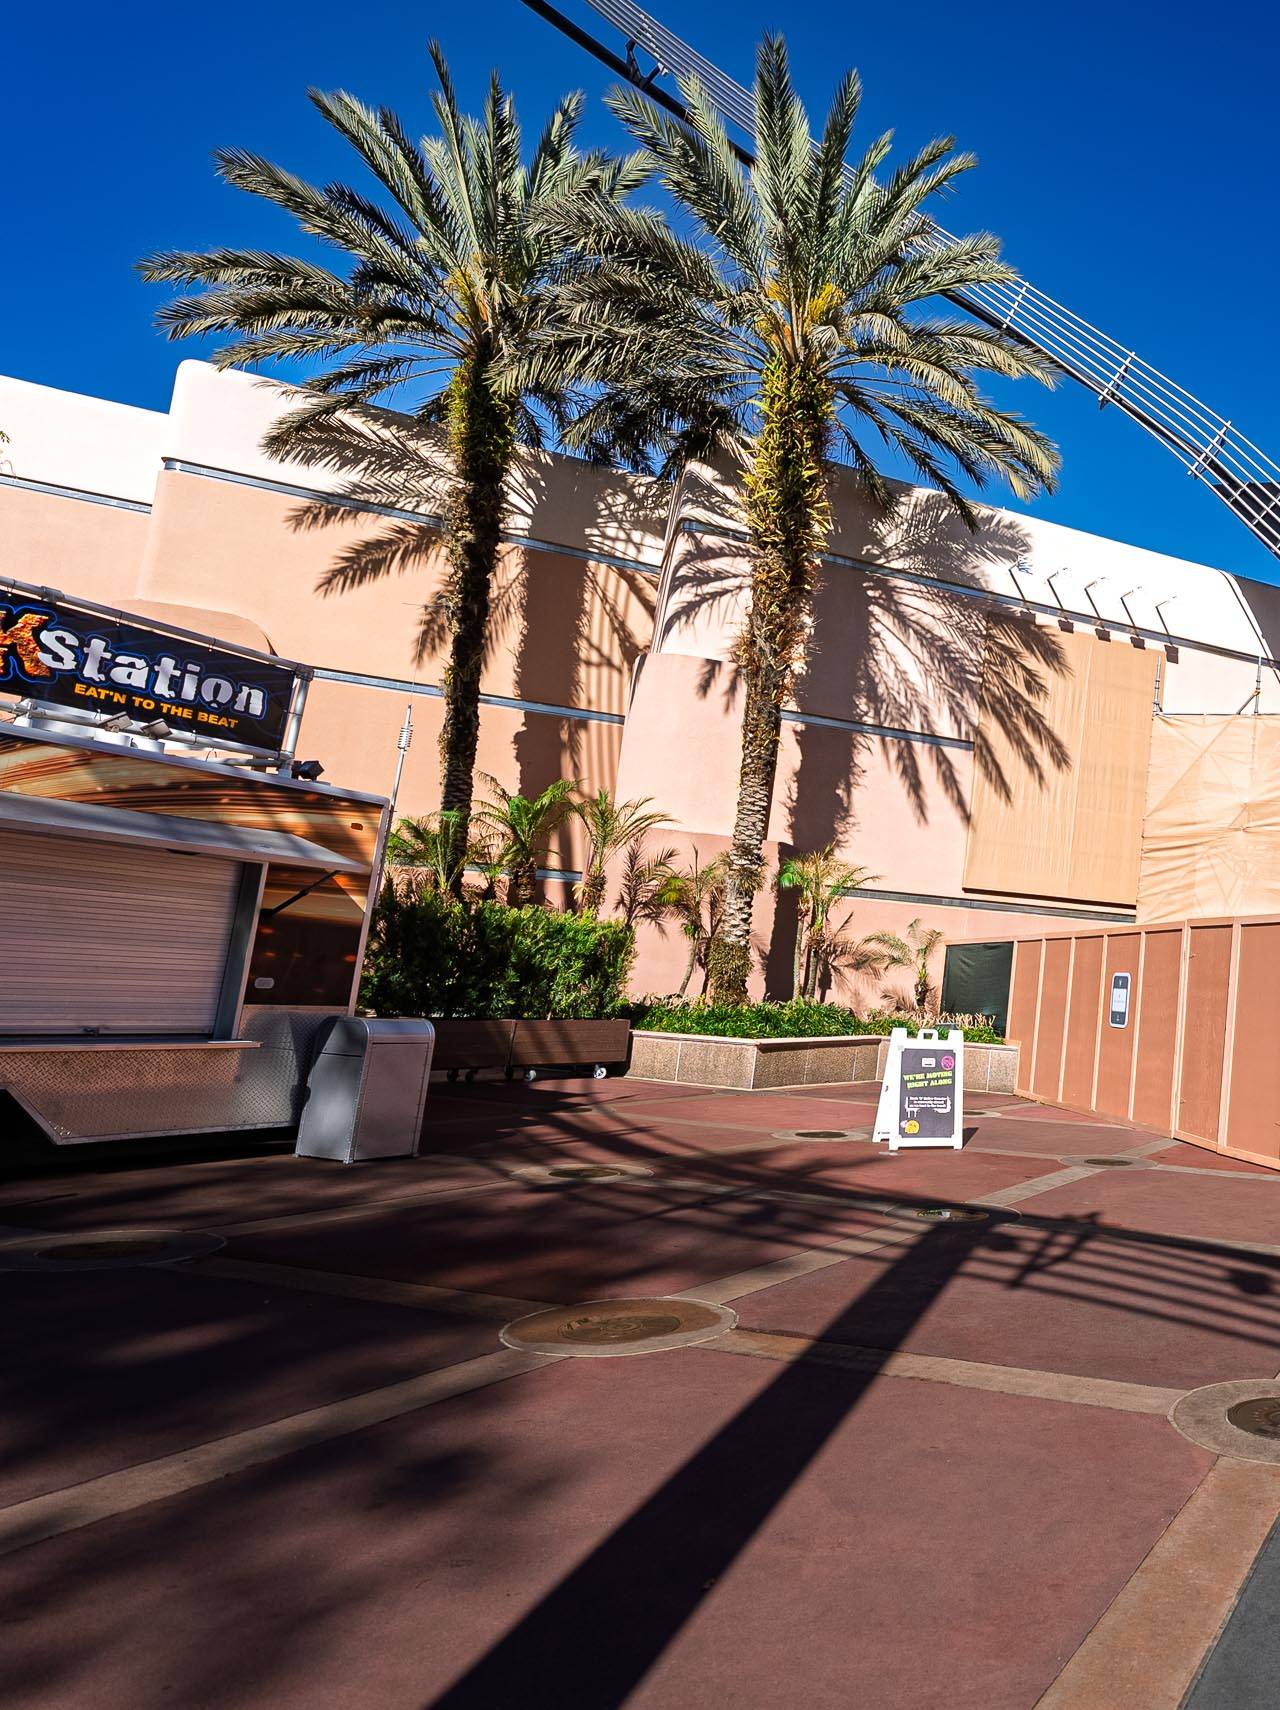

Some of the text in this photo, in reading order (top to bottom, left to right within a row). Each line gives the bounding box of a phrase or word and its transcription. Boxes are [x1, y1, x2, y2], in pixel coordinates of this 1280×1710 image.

[74, 683, 239, 729] EAT'N TO THE BEAT
[930, 1079, 952, 1087] ALONG
